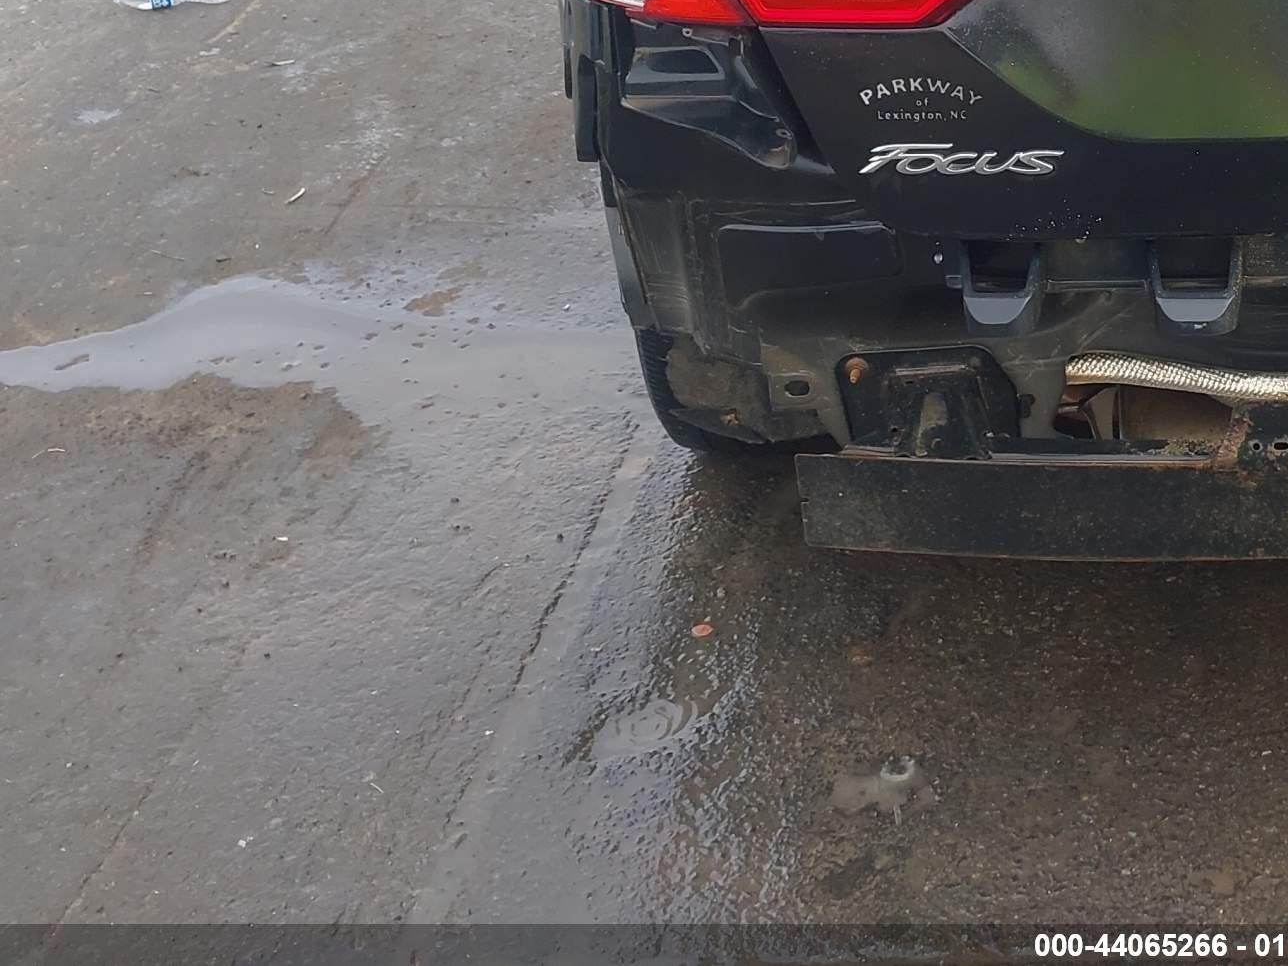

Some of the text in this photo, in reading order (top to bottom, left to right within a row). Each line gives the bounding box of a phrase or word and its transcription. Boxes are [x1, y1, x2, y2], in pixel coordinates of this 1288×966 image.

[859, 77, 983, 105] PARKWAY
[915, 97, 929, 107] of
[877, 108, 967, 123] Lexington, NC
